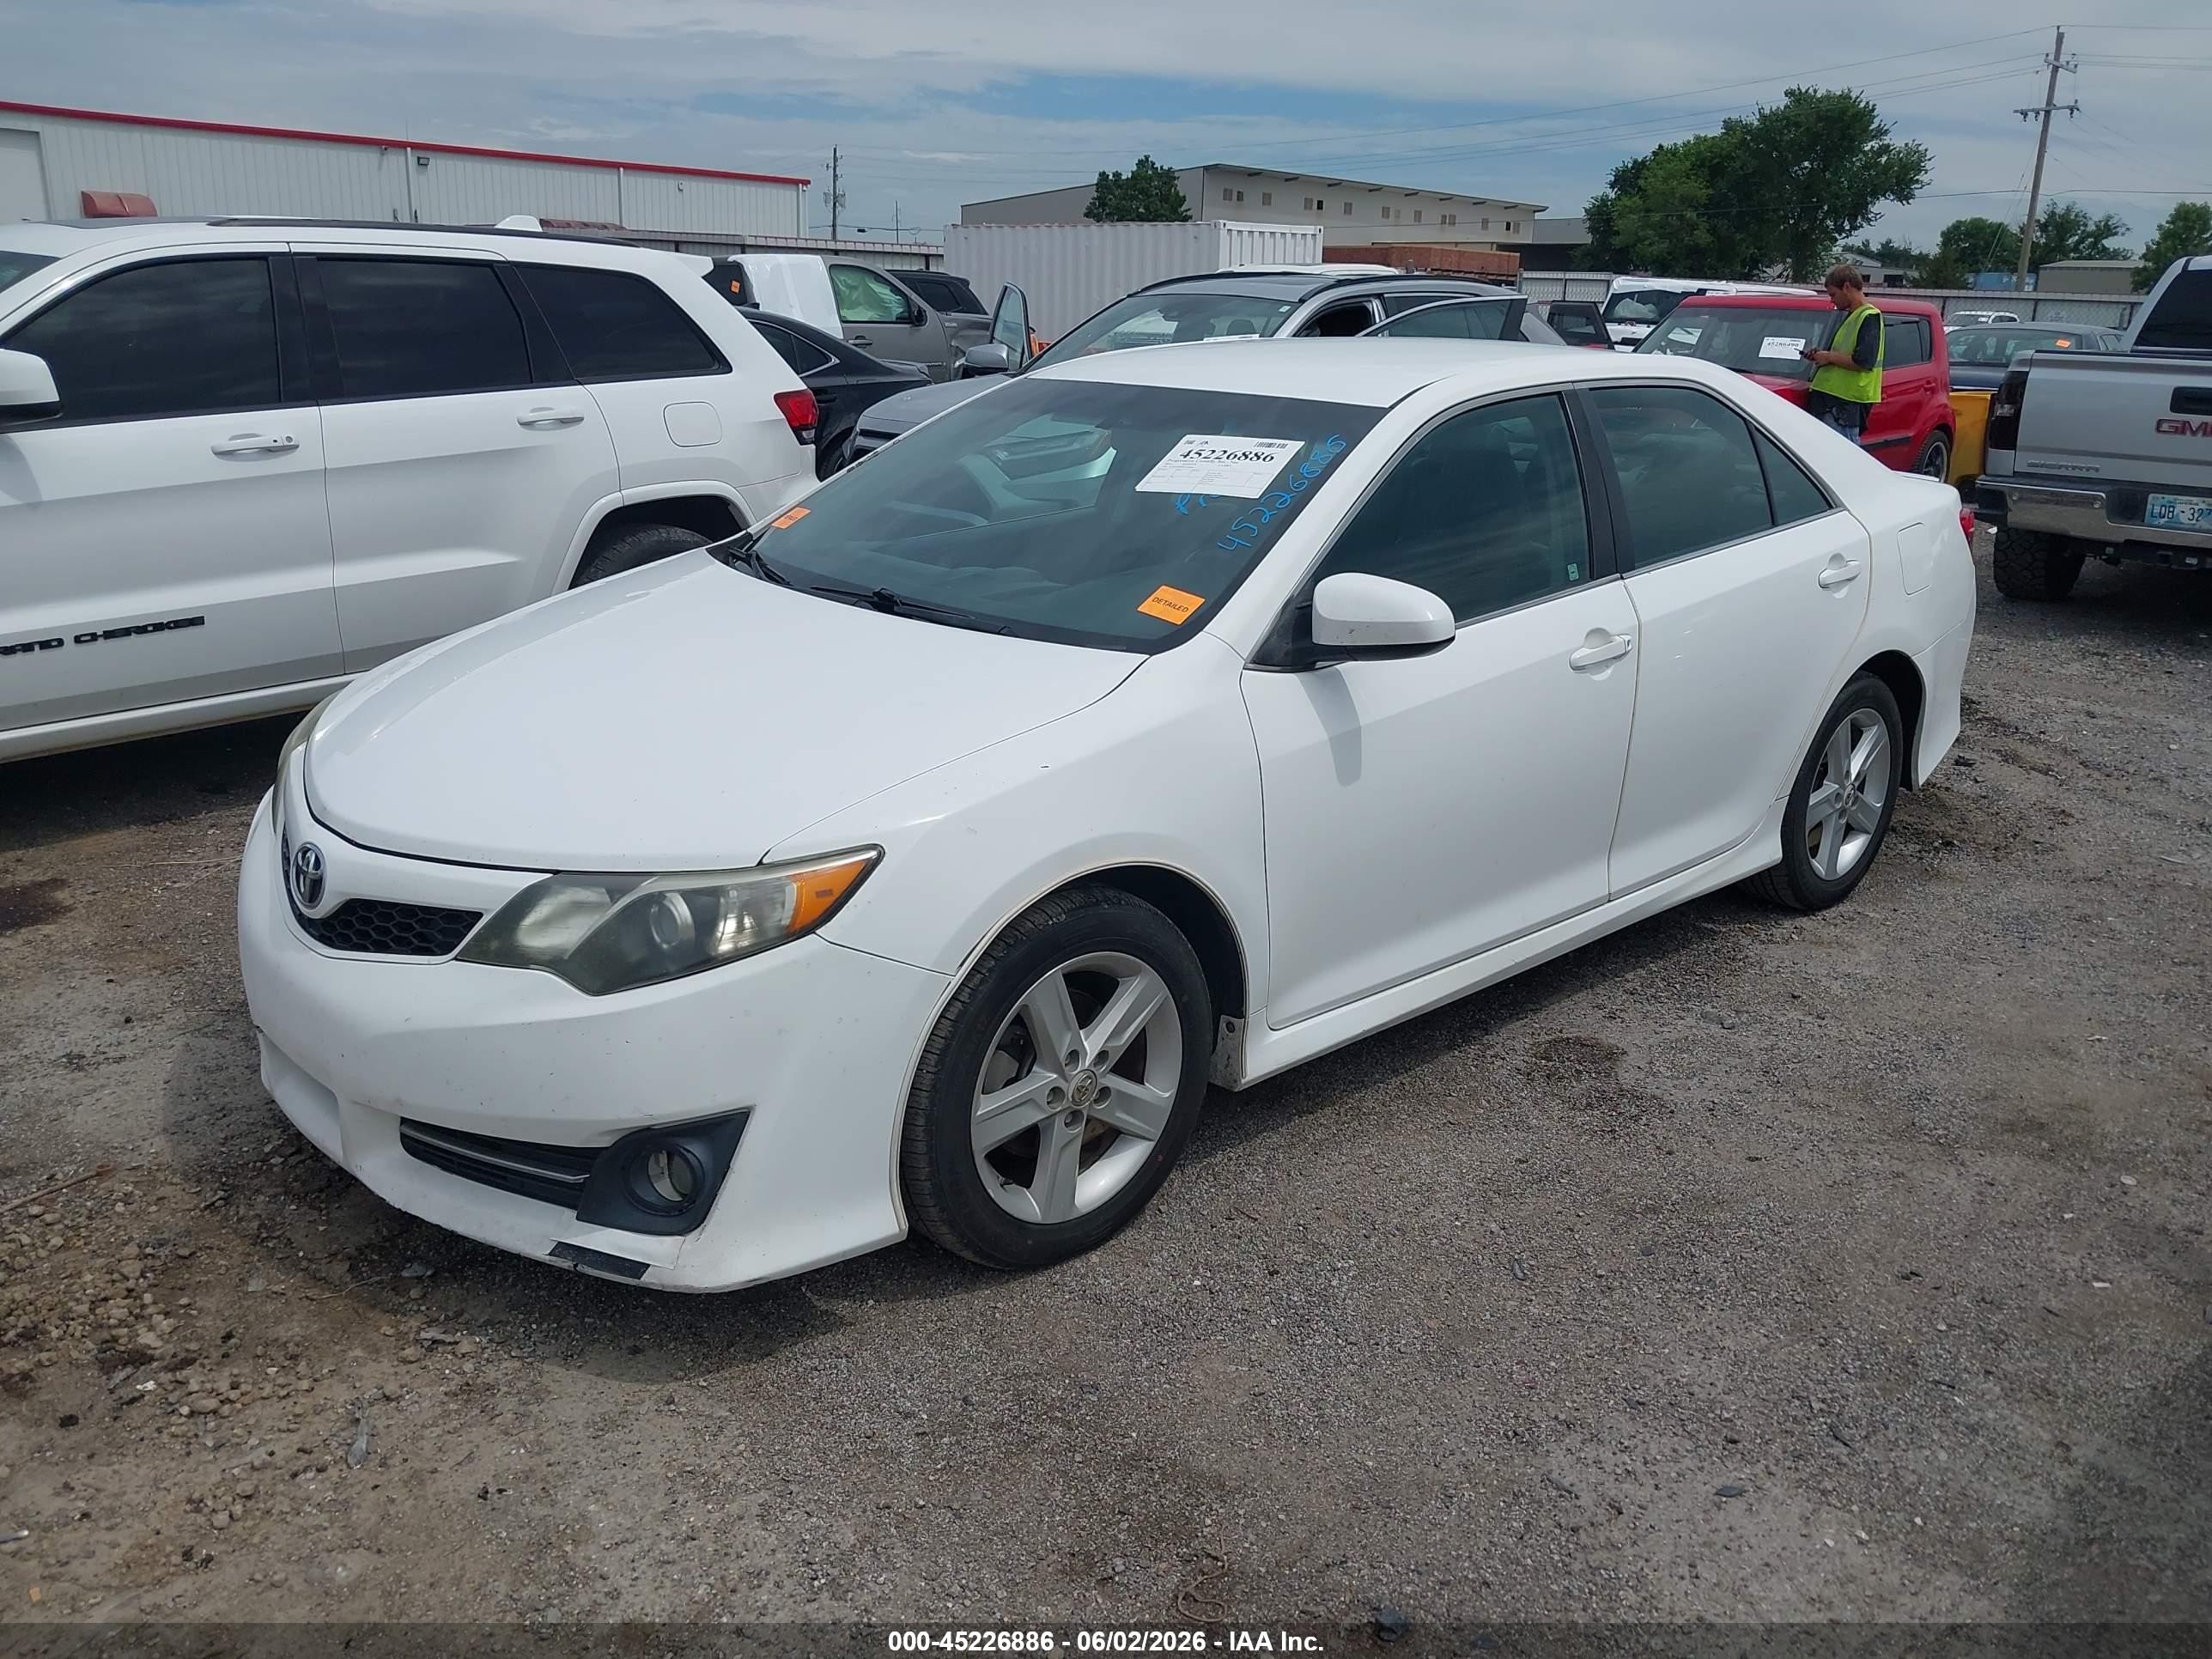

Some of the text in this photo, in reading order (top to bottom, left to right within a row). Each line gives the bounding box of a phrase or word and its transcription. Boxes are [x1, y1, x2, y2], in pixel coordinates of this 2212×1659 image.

[2156, 418, 2212, 438] GM
[1179, 448, 1278, 463] 45226886
[1152, 597, 1189, 613] DETAILED
[74, 616, 205, 644] CHEROKEE
